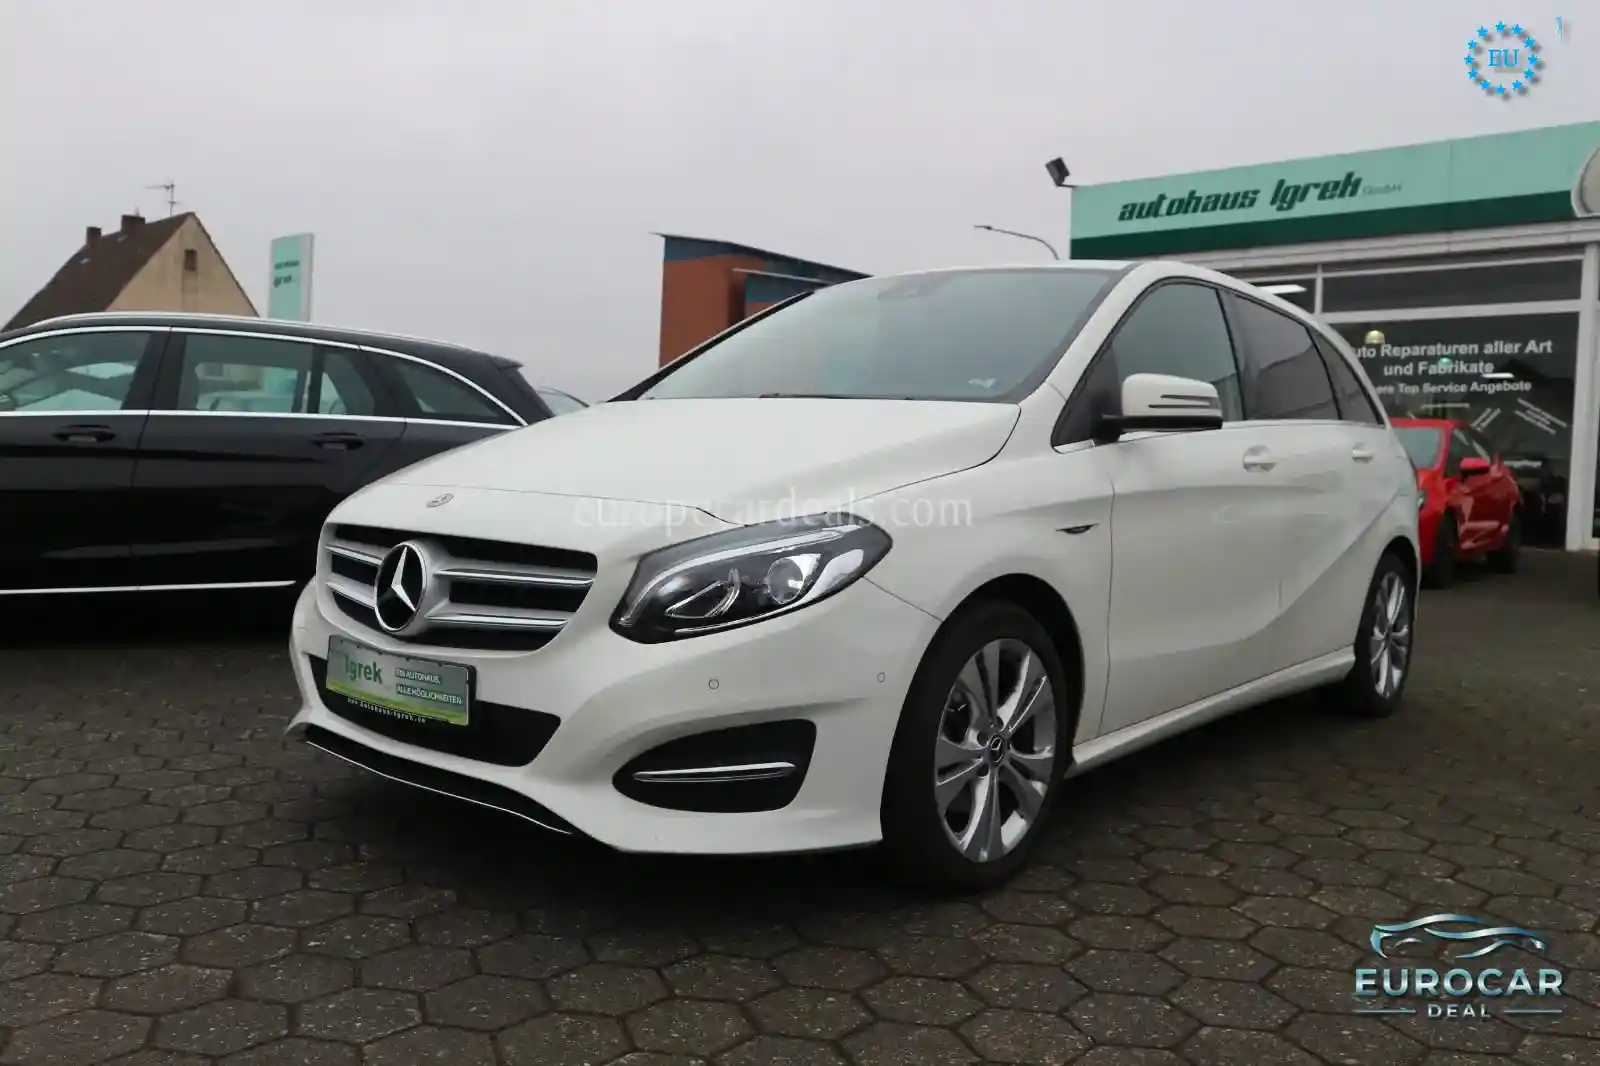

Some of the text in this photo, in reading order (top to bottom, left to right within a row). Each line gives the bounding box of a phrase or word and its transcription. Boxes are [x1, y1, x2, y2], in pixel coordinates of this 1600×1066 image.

[1118, 189, 1261, 222] autohaus
[1269, 171, 1363, 212] Igrek
[1354, 339, 1553, 360] uto Reparaturen aller Art
[1383, 360, 1495, 376] und Fabrikate
[1422, 381, 1468, 394] Service
[1469, 380, 1532, 395] Angebote
[344, 653, 383, 685] Igrek
[397, 685, 411, 694] ALLE
